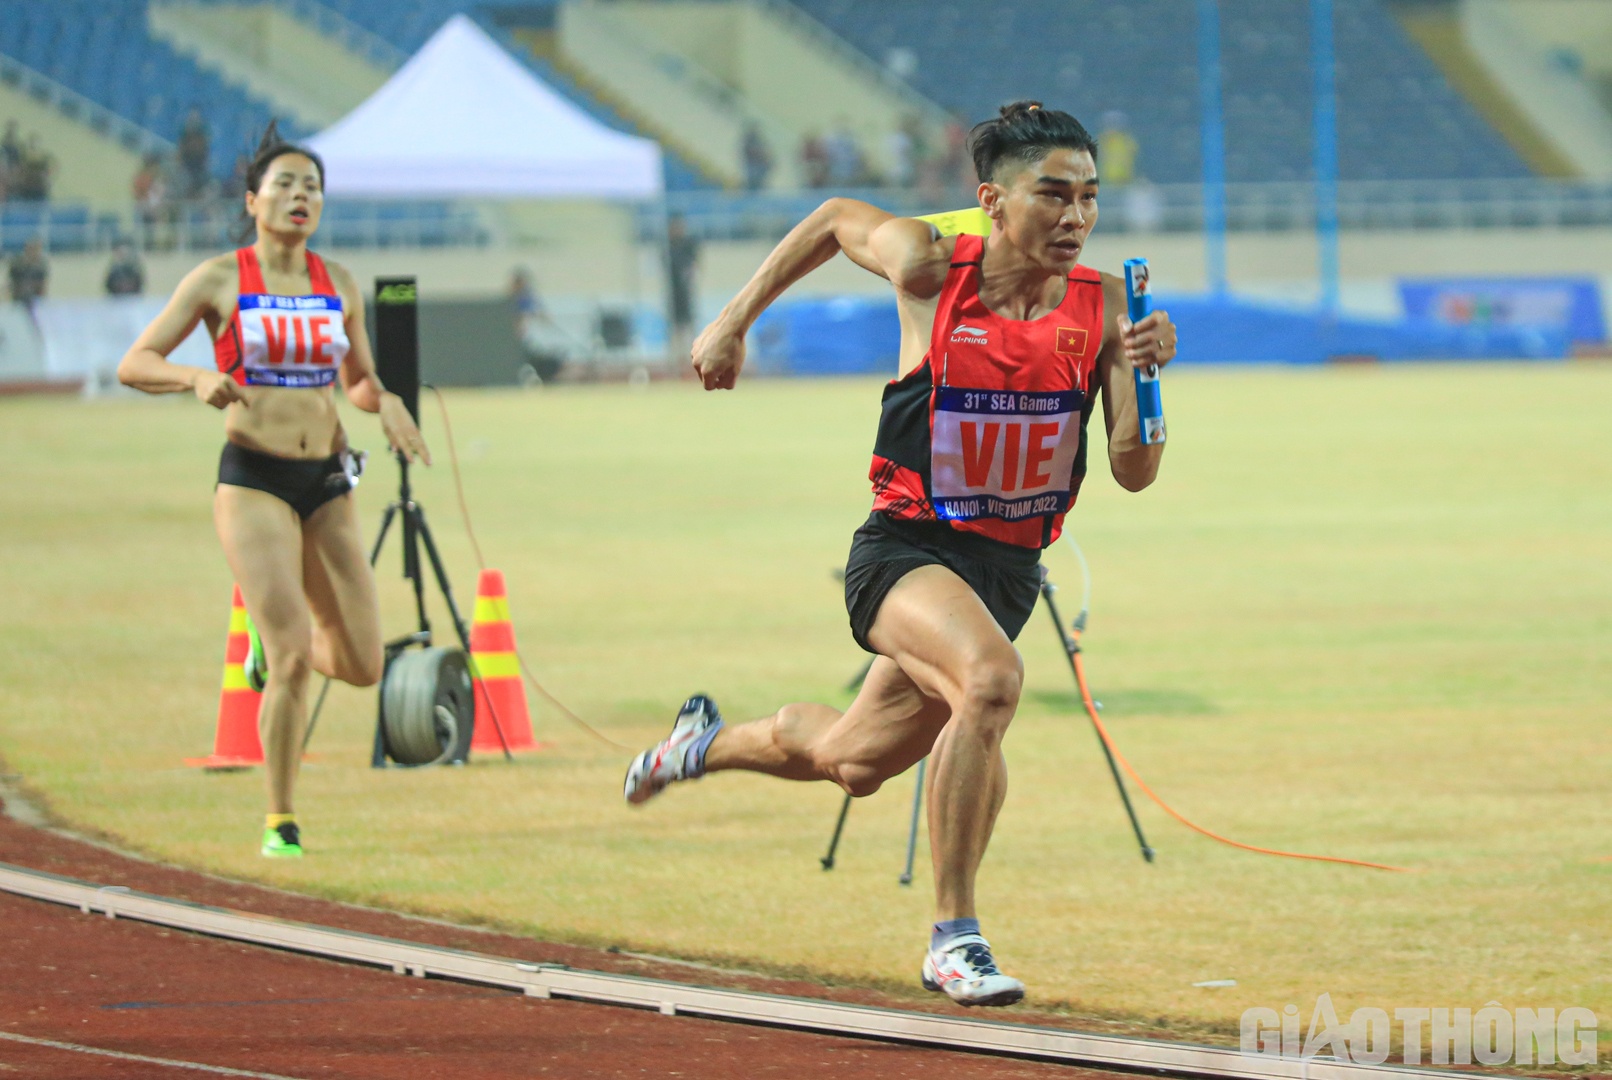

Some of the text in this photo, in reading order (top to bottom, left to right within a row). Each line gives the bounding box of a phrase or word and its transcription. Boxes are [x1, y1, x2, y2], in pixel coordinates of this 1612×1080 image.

[260, 315, 334, 364] VIE
[950, 335, 988, 345] LI-NING
[990, 393, 1015, 411] SEA
[1019, 396, 1060, 411] Games
[960, 421, 1059, 492] VIE
[944, 500, 980, 517] HANOI
[987, 498, 1031, 519] VIETNAM
[1032, 495, 1058, 513] 2022
